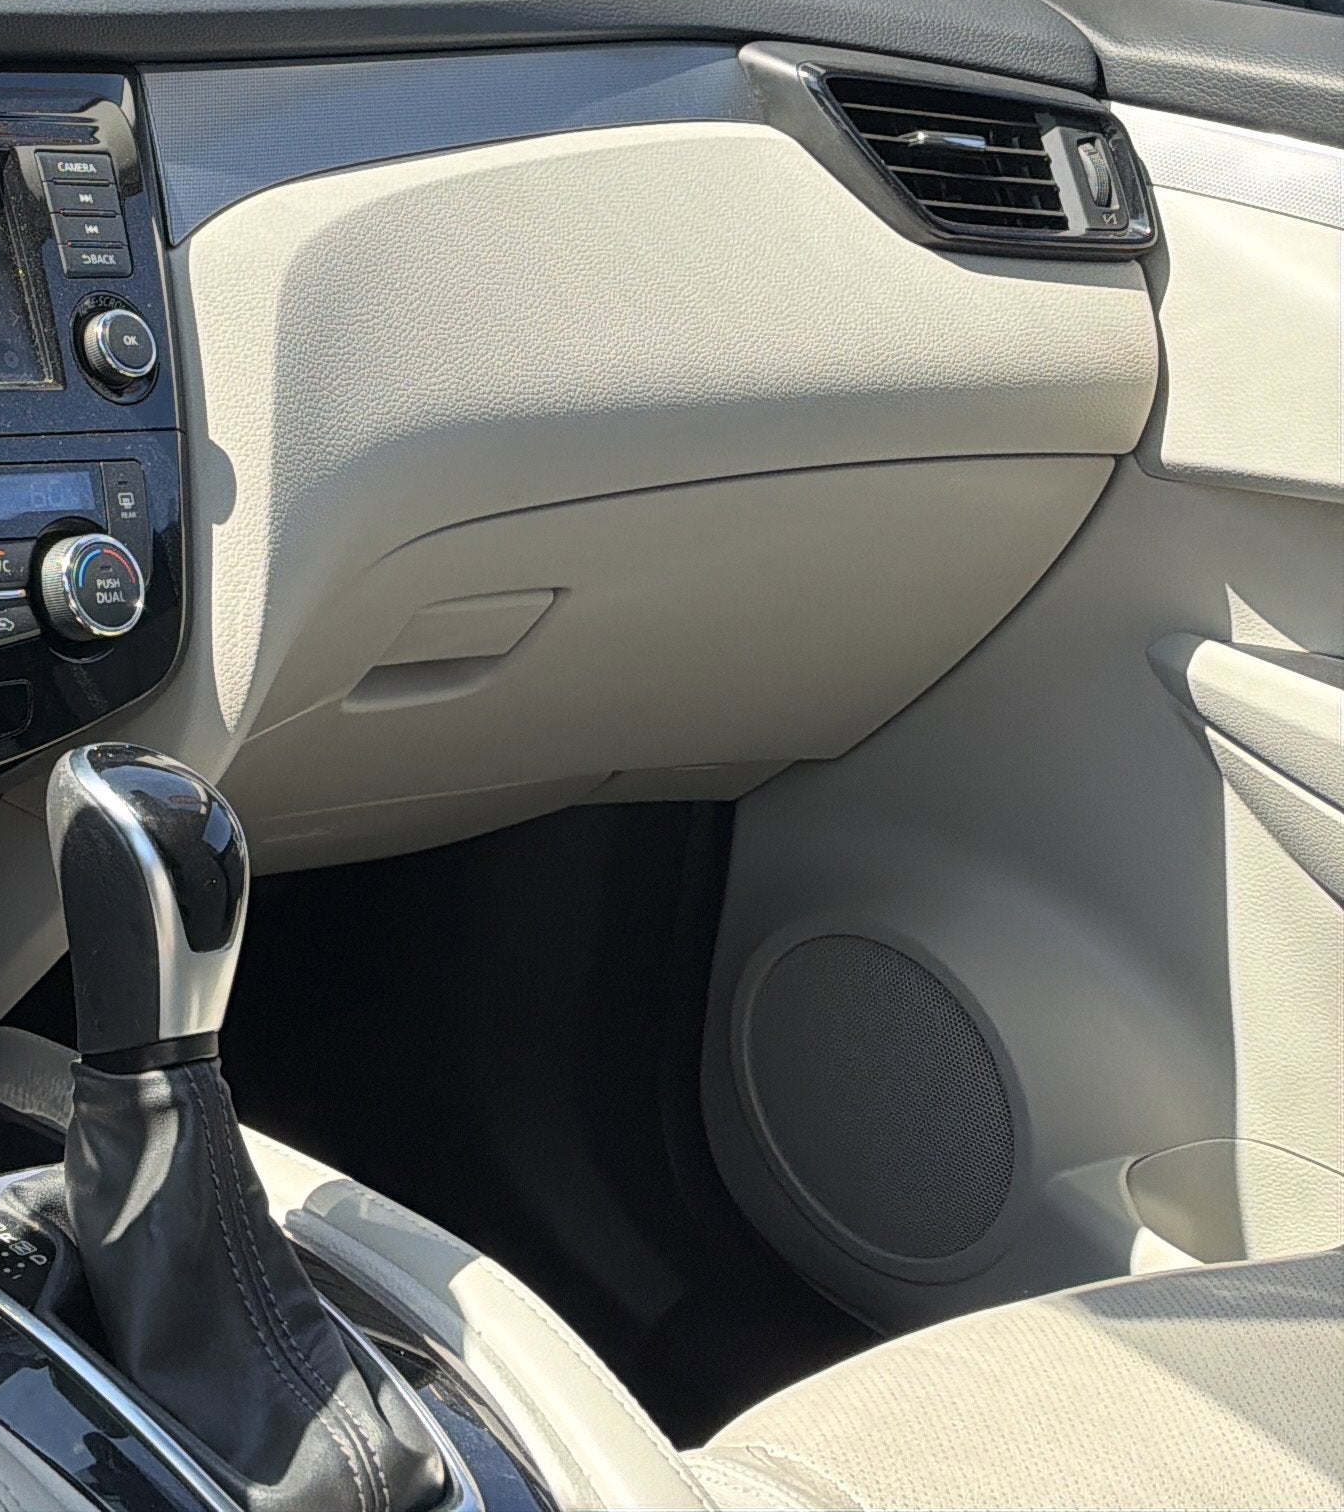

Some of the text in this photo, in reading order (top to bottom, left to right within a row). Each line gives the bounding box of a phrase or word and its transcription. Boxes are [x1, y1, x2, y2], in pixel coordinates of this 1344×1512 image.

[57, 161, 97, 174] CAMERA
[90, 253, 117, 265] BACK
[122, 334, 140, 347] OK
[95, 578, 121, 589] PUSH
[95, 590, 126, 605] DUAL
[28, 1255, 48, 1266] D
